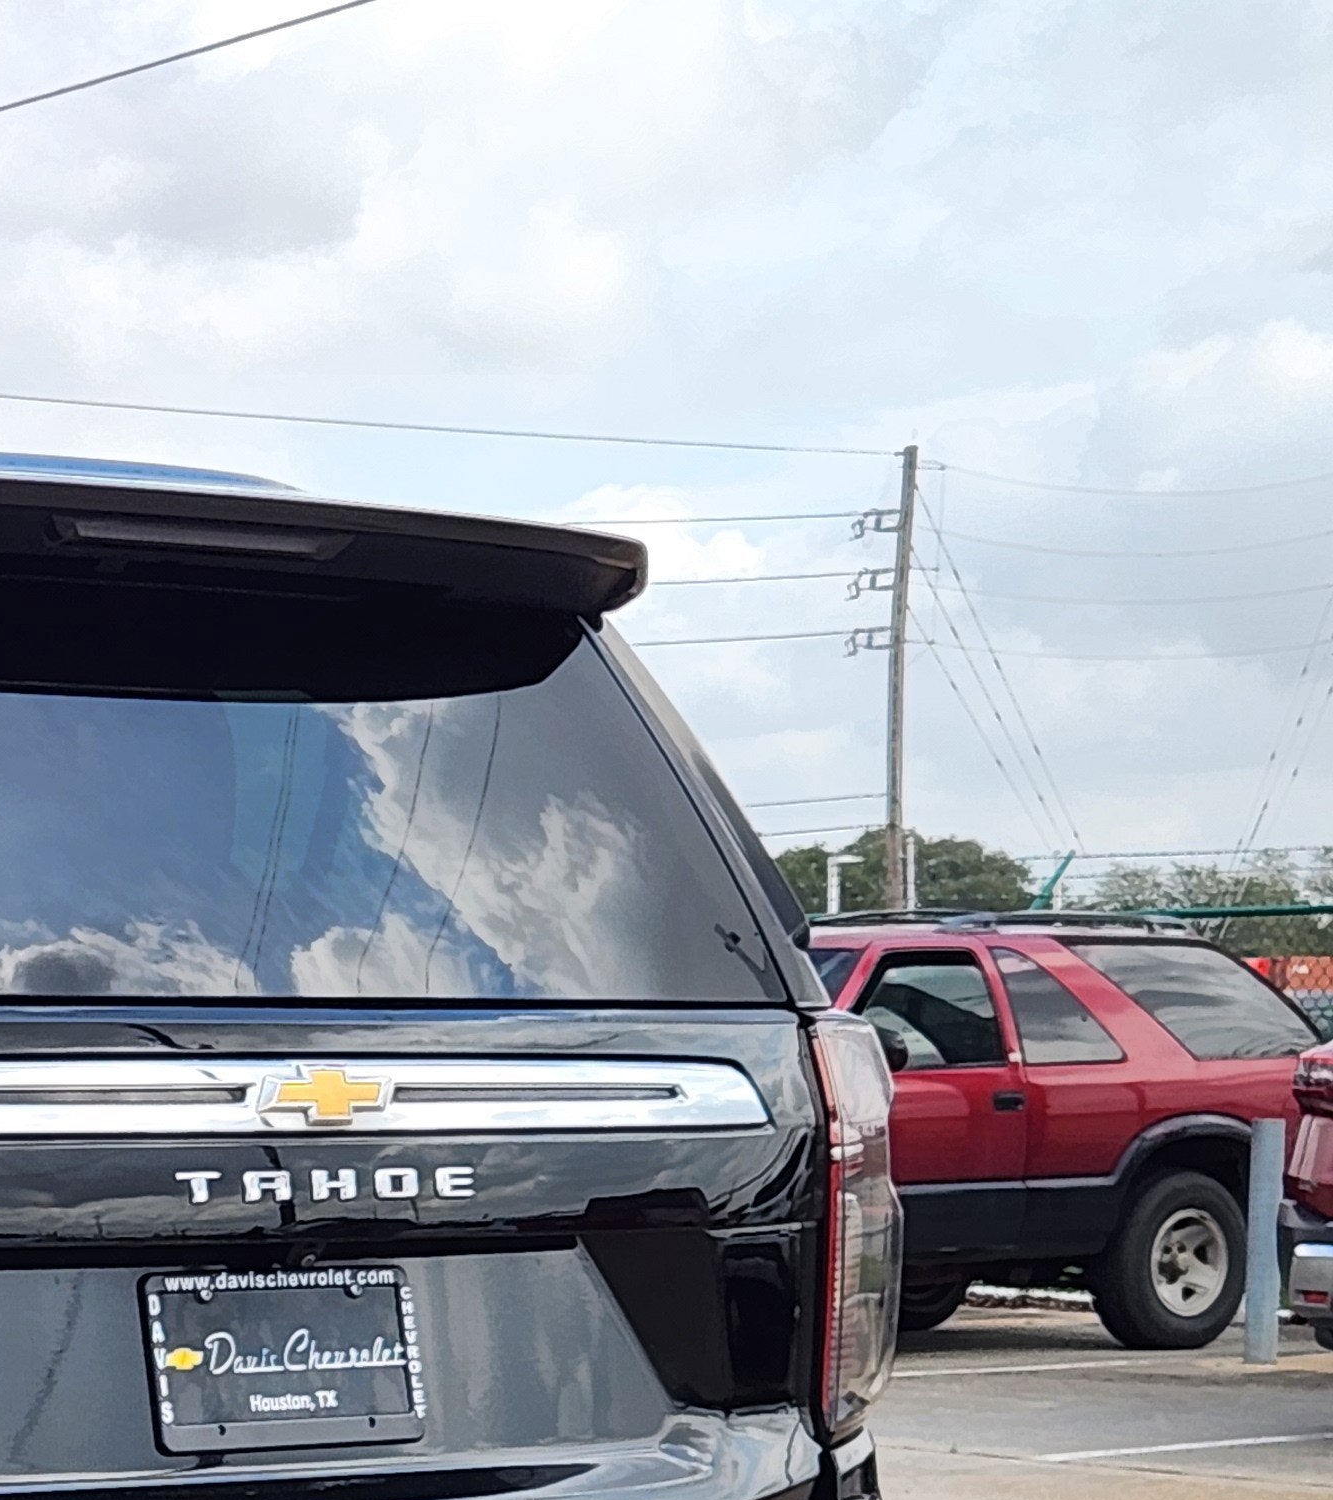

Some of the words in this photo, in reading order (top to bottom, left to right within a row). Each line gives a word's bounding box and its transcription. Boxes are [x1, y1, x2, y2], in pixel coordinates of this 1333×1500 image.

[174, 1166, 476, 1204] TAHOE
[164, 1268, 395, 1292] www.davischevrolet.com
[148, 1293, 174, 1425] DAVIS
[204, 1331, 284, 1375] Davis
[283, 1328, 407, 1371] Chevrolet
[399, 1286, 427, 1420] CHEVROLET
[249, 1393, 316, 1414] Houston,
[316, 1389, 339, 1409] TX
